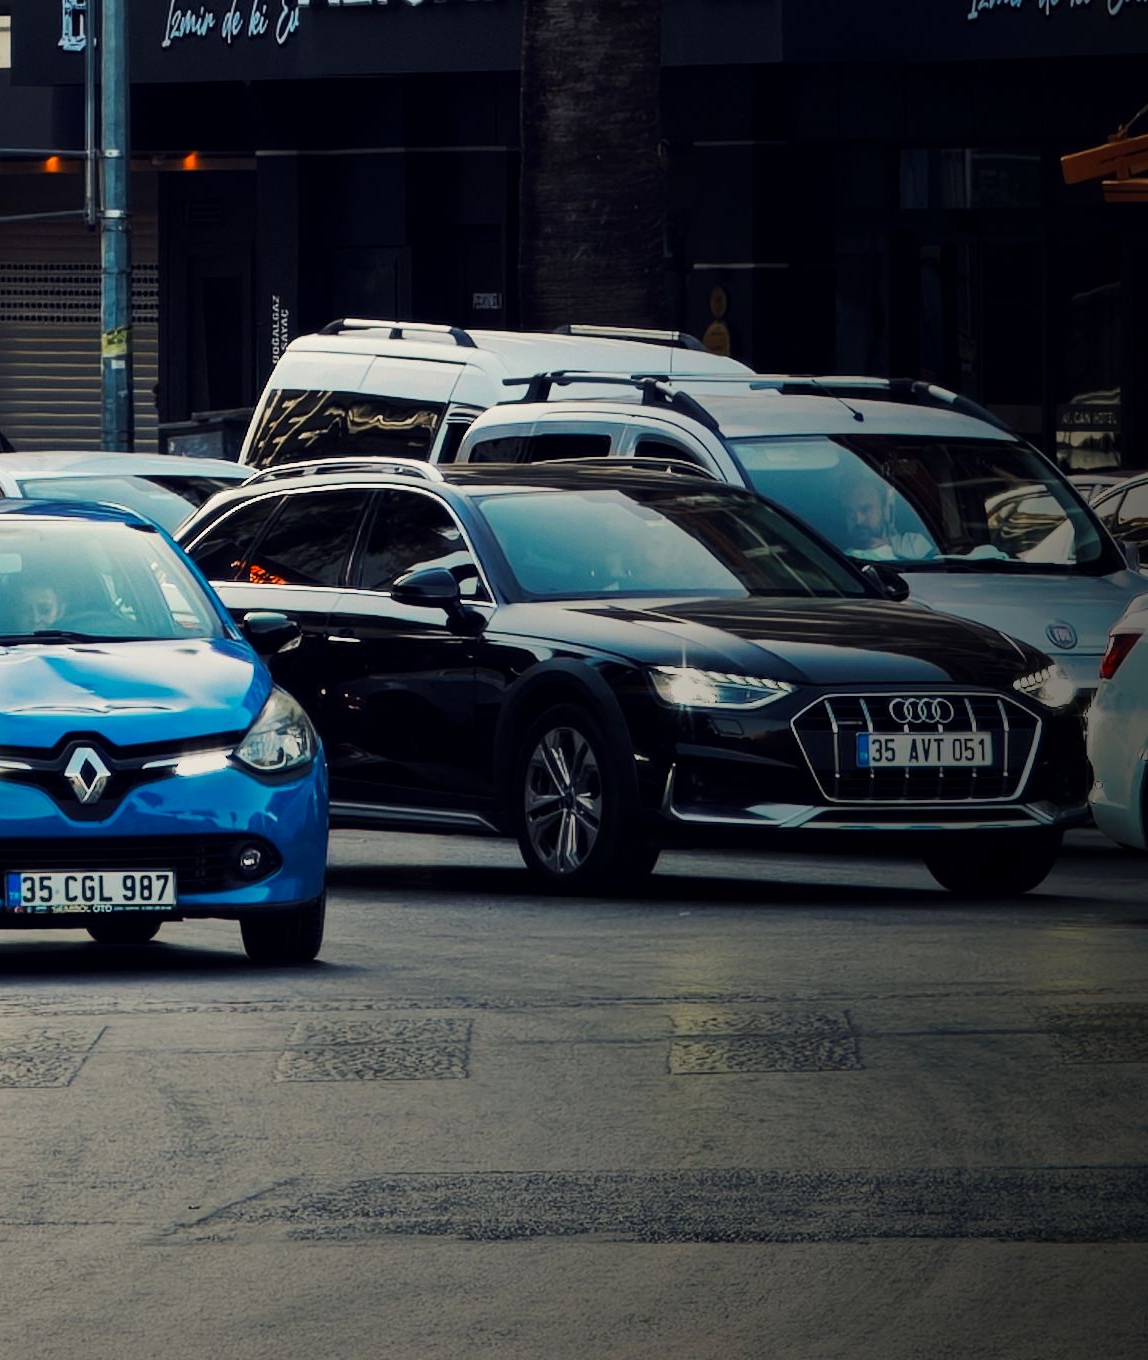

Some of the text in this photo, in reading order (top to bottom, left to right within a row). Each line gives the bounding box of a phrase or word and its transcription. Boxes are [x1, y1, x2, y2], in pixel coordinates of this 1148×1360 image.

[871, 737, 987, 763] 35 AVT 051
[22, 875, 52, 903] 35
[64, 875, 114, 903] CGL
[122, 874, 170, 902] 987
